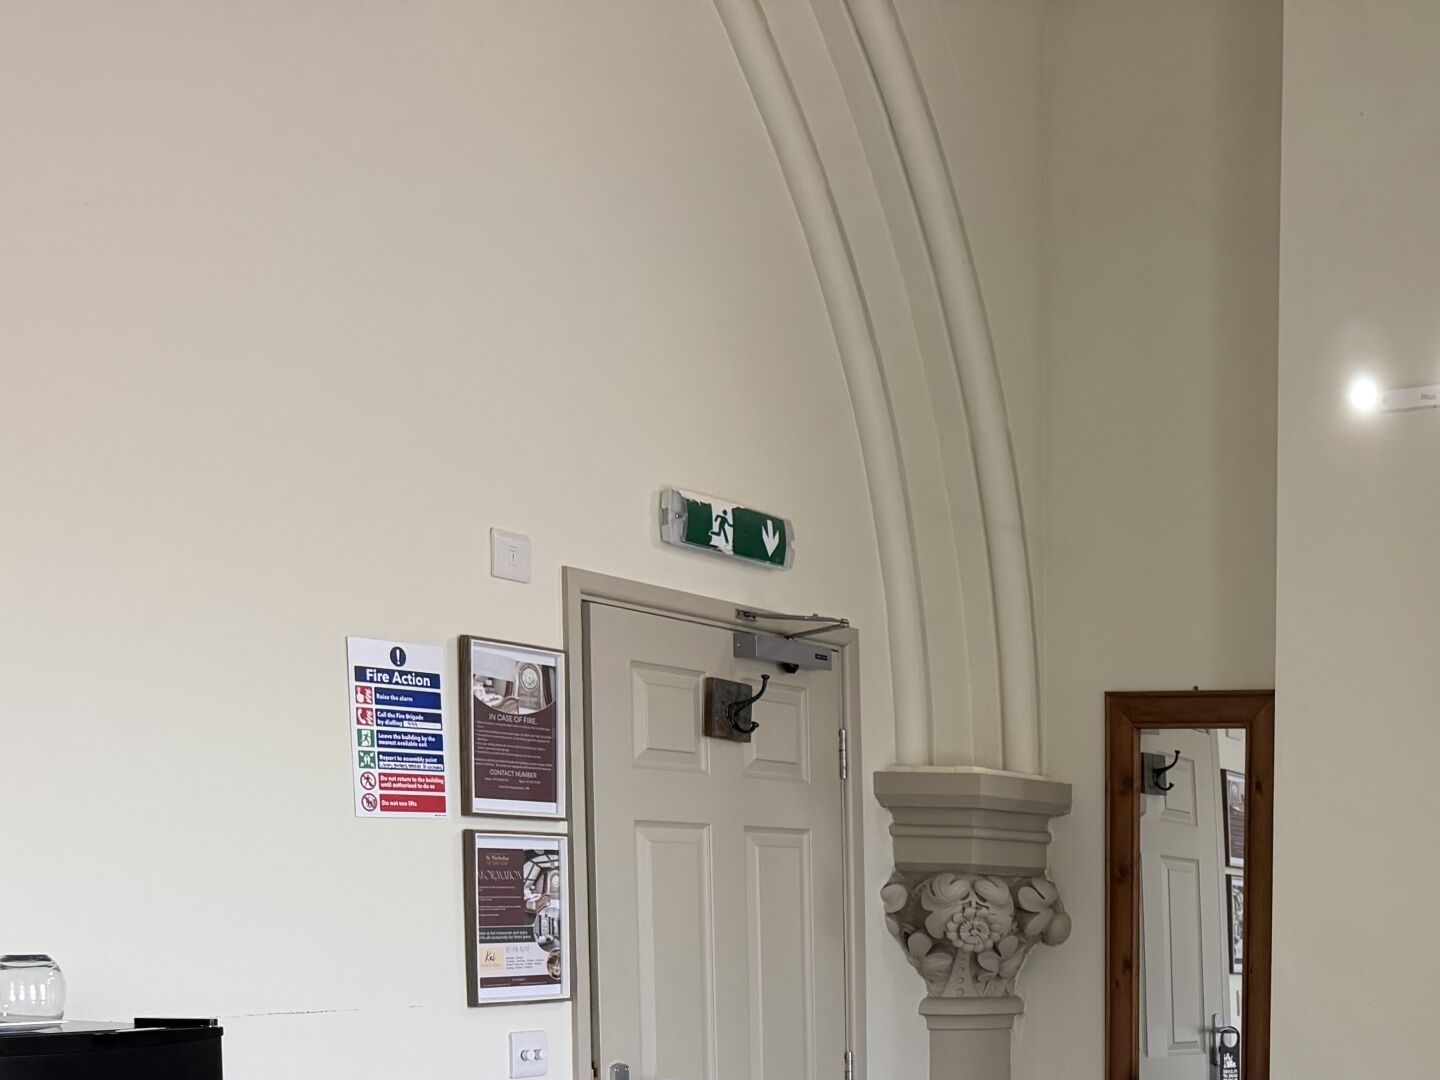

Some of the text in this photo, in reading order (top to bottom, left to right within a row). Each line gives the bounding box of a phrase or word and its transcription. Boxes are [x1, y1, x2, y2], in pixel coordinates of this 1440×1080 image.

[366, 669, 430, 686] Fire Action
[497, 714, 512, 722] CASE
